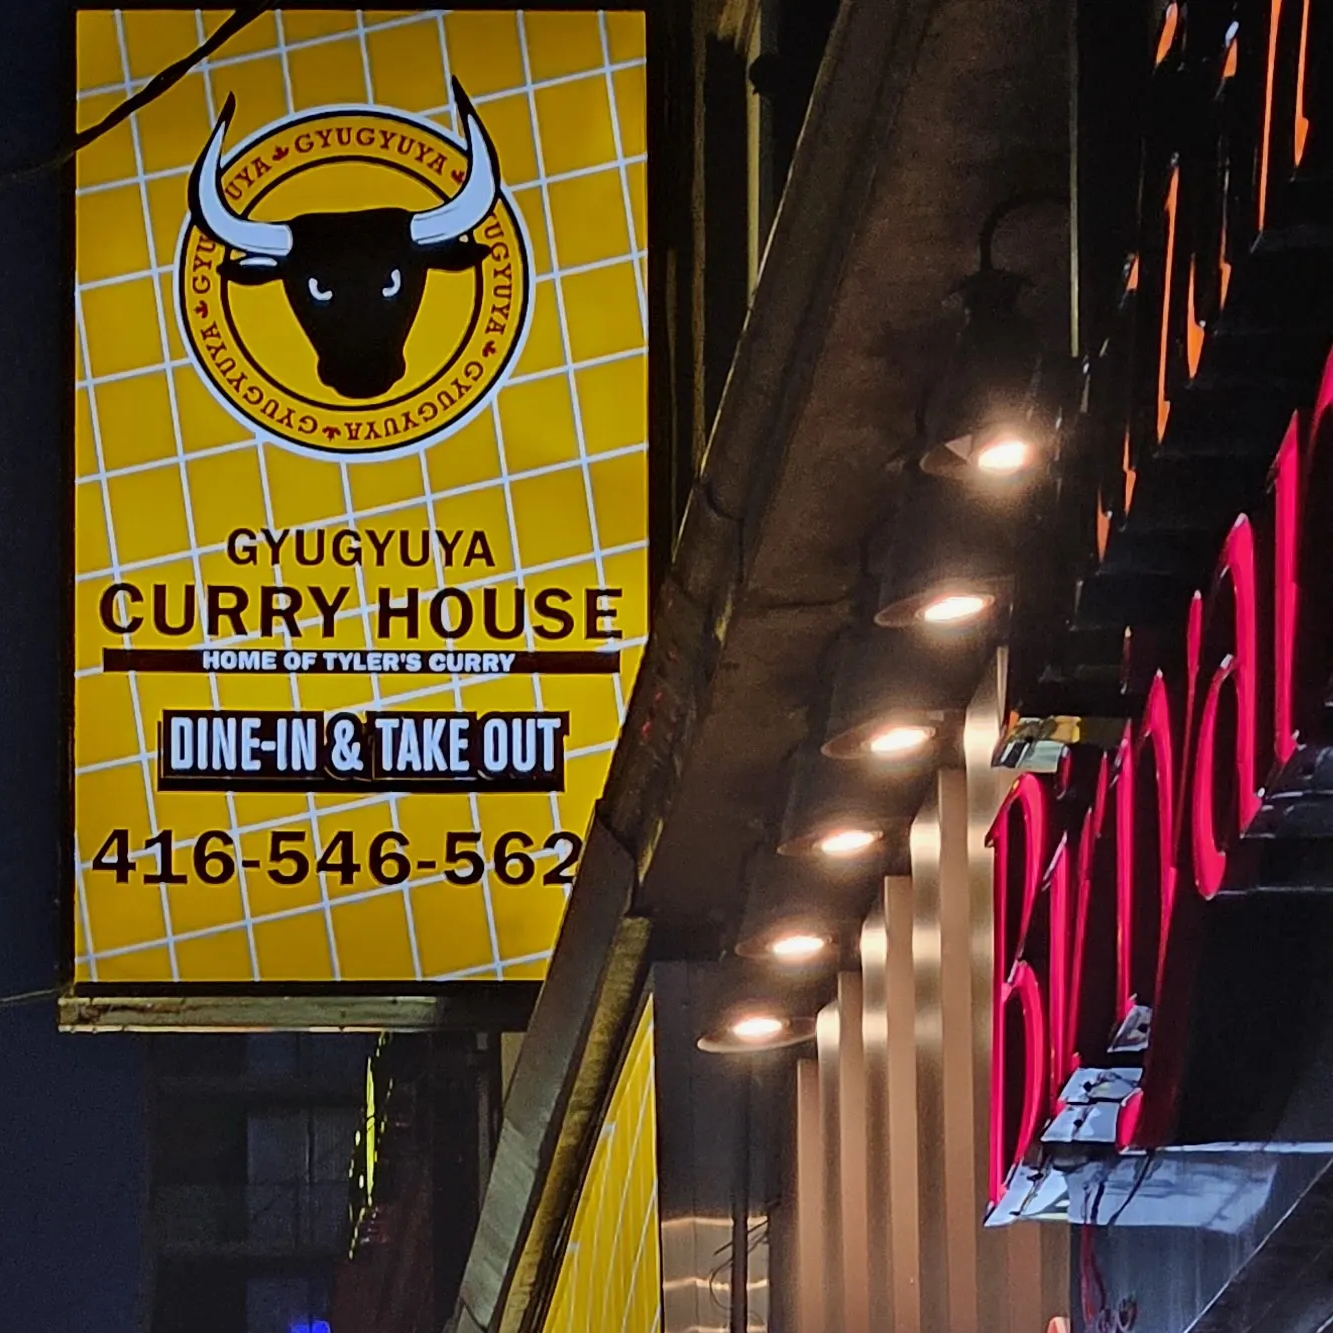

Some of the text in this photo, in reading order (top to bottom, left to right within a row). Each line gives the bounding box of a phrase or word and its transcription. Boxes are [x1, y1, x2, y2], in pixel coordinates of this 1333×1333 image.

[294, 127, 449, 182] GYUGYUYA
[200, 320, 319, 434] GYUGYUYA
[344, 360, 485, 441] GYUGYUYA
[227, 529, 495, 567] GYUGYUYA
[99, 582, 624, 640] CURRY HOUSE
[203, 651, 515, 673] HOME OF TYLER'S CURRY
[170, 716, 562, 773] DINE-IN & TAKE OUT
[92, 829, 584, 886] 416-546-562
